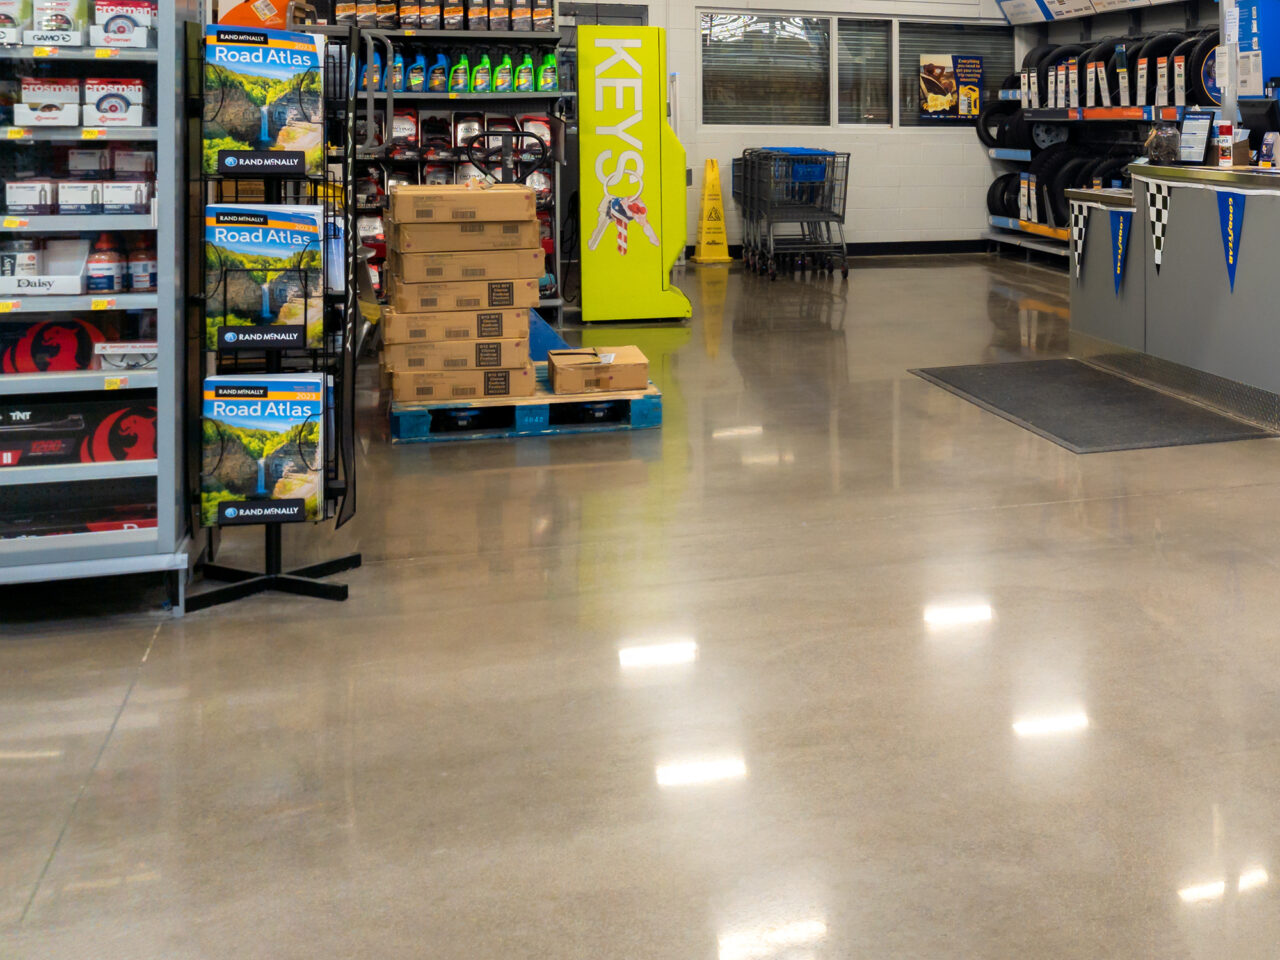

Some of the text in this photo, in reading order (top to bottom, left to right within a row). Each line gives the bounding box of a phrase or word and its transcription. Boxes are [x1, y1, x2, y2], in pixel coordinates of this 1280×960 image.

[95, 5, 151, 16] crosman
[33, 34, 60, 42] GAMO
[215, 46, 312, 66] Road Atlas
[22, 83, 79, 93] crosman
[85, 83, 143, 93] crosman
[594, 38, 645, 186] KEYS
[239, 158, 262, 166] RAND
[215, 228, 311, 245] Road Atlas
[17, 279, 55, 290] Daisy
[213, 401, 312, 417] Road Atlas
[9, 411, 32, 420] TNT
[239, 508, 263, 516] RAND
